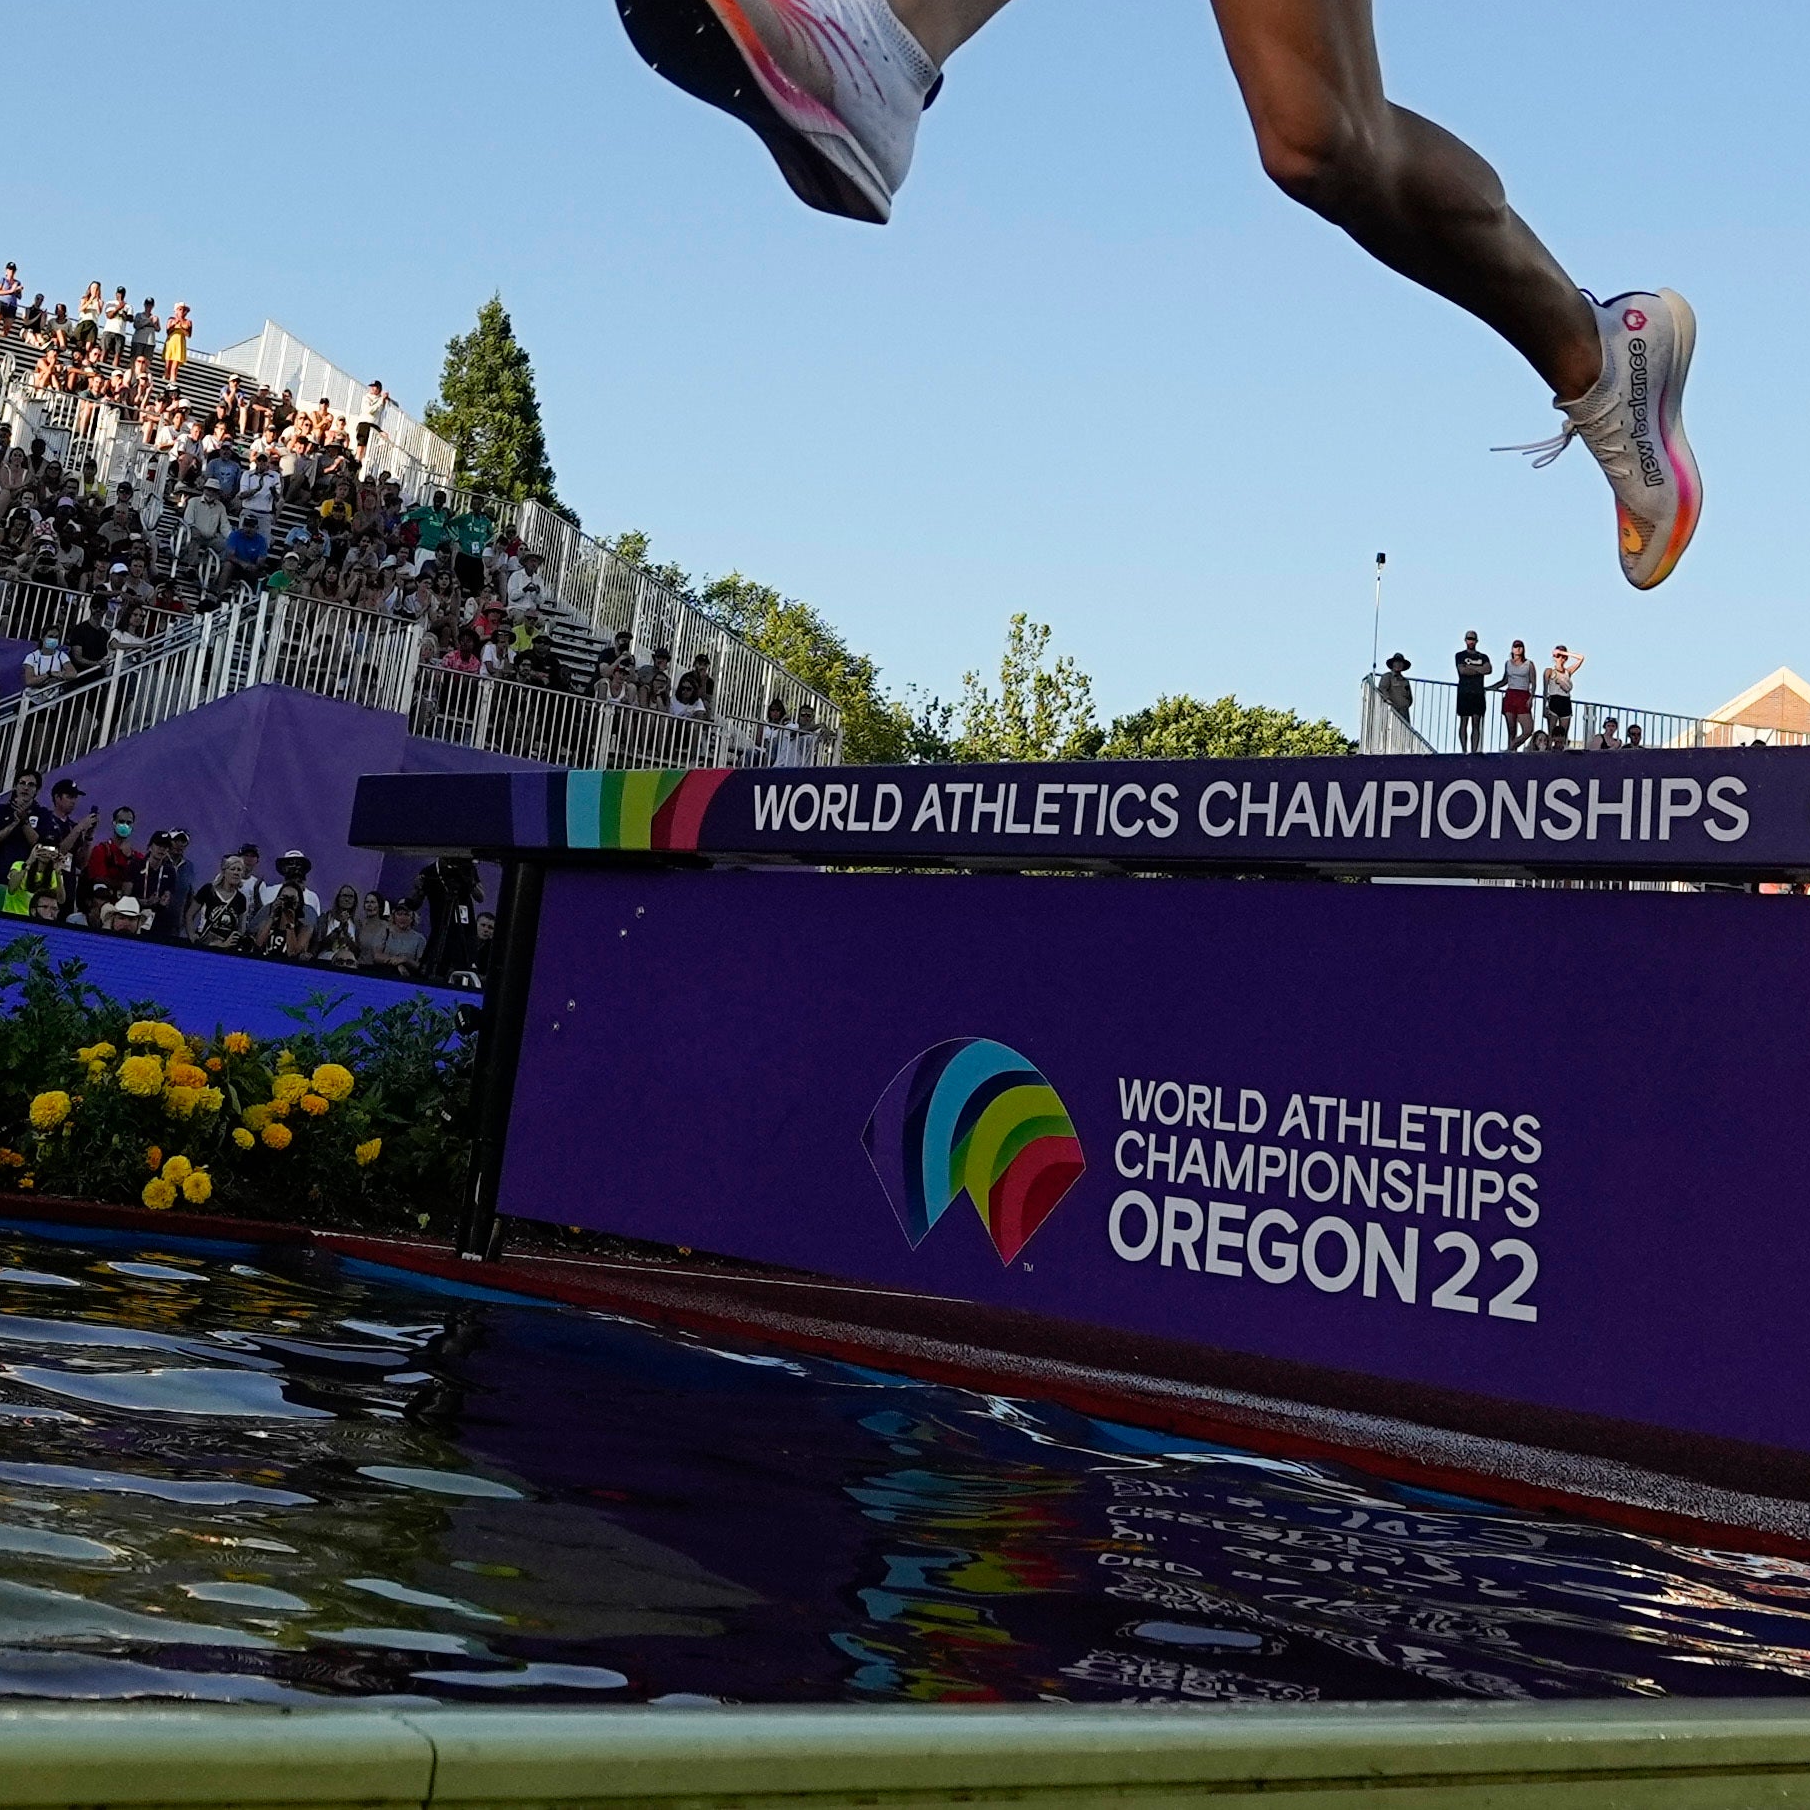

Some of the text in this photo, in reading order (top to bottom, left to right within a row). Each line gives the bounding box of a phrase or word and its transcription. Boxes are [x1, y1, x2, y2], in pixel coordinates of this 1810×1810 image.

[1628, 337, 1664, 488] new balance
[754, 783, 902, 832] WORLD
[910, 783, 1180, 838] ATHLETICS
[1198, 775, 1750, 842] CHAMPIONSHIPS
[1118, 1077, 1542, 1164] WORLD ATHLETICS
[1114, 1130, 1540, 1228] CHAMPIONSHIPS
